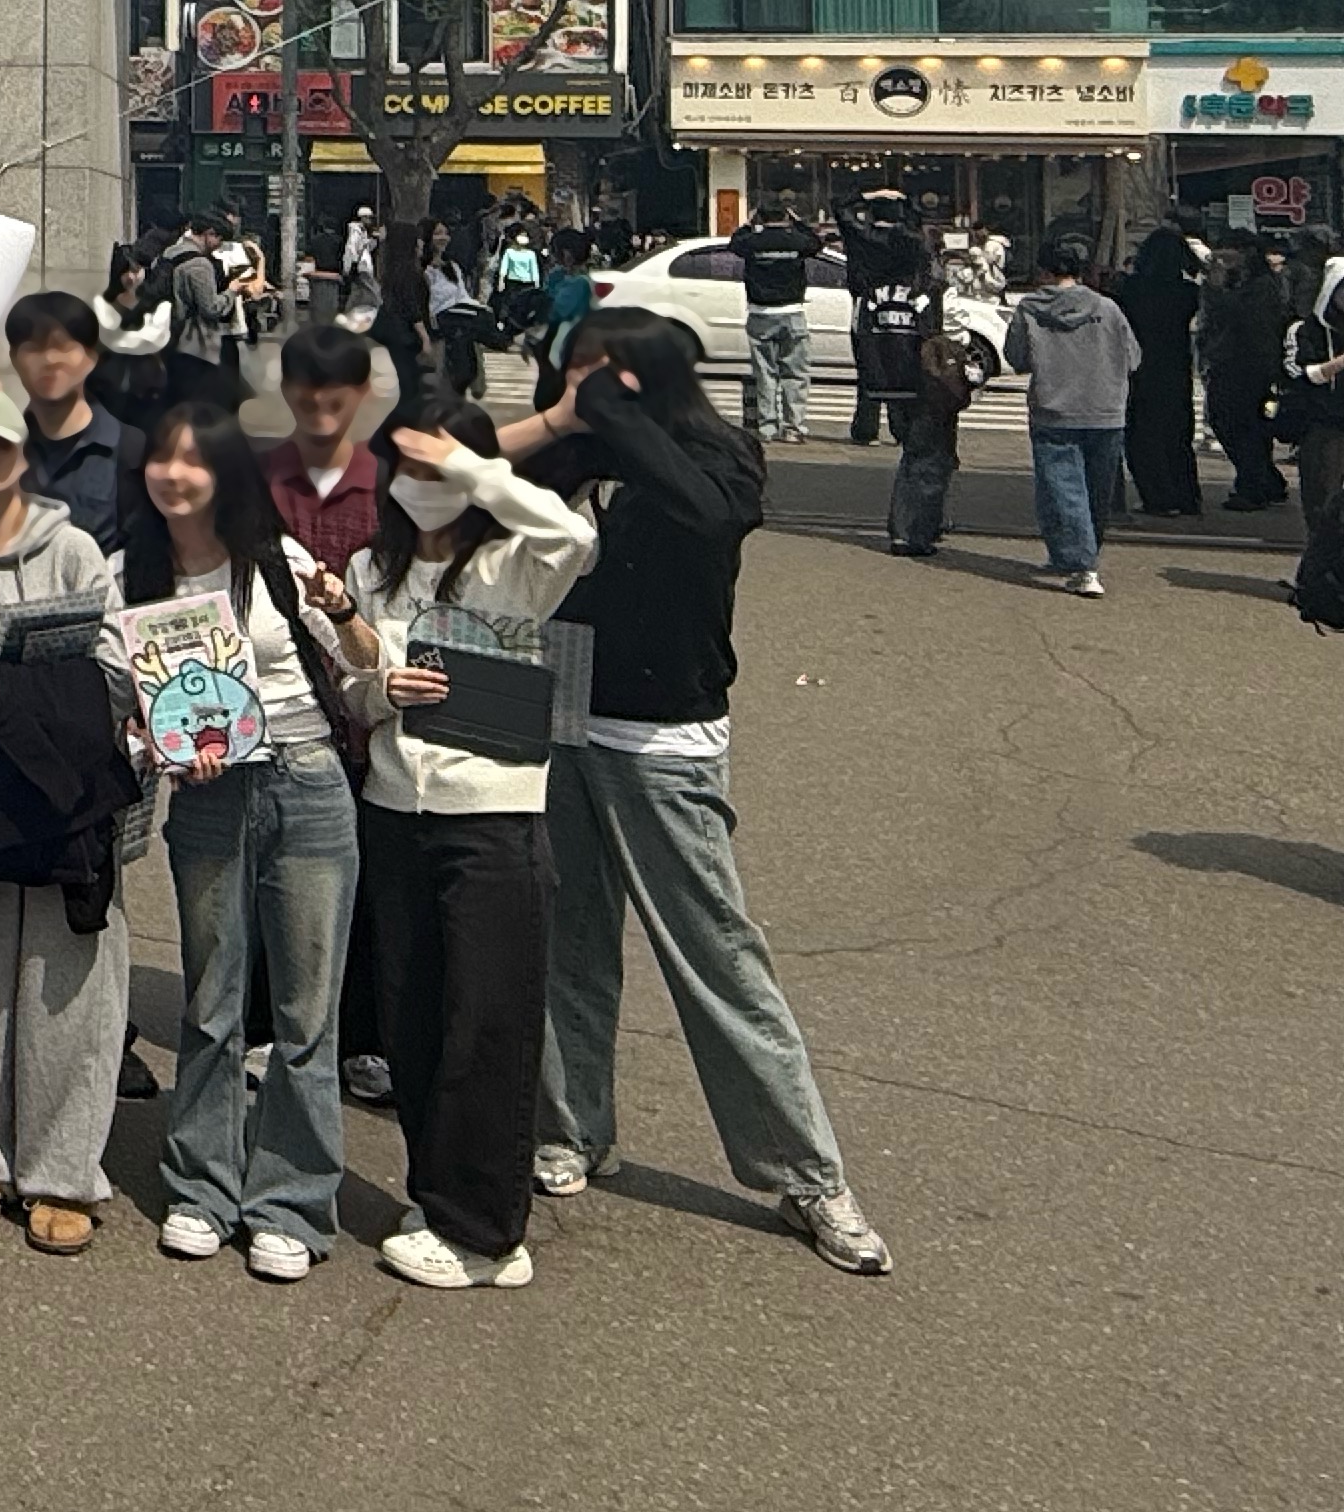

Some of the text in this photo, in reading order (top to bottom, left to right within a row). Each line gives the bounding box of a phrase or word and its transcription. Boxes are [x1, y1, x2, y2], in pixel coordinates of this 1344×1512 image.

[763, 83, 815, 99] 돈카츠
[990, 85, 1134, 102] 치즈카츠 냉소바
[384, 95, 611, 115] COMSE COFFEE
[1251, 176, 1312, 224] 약
